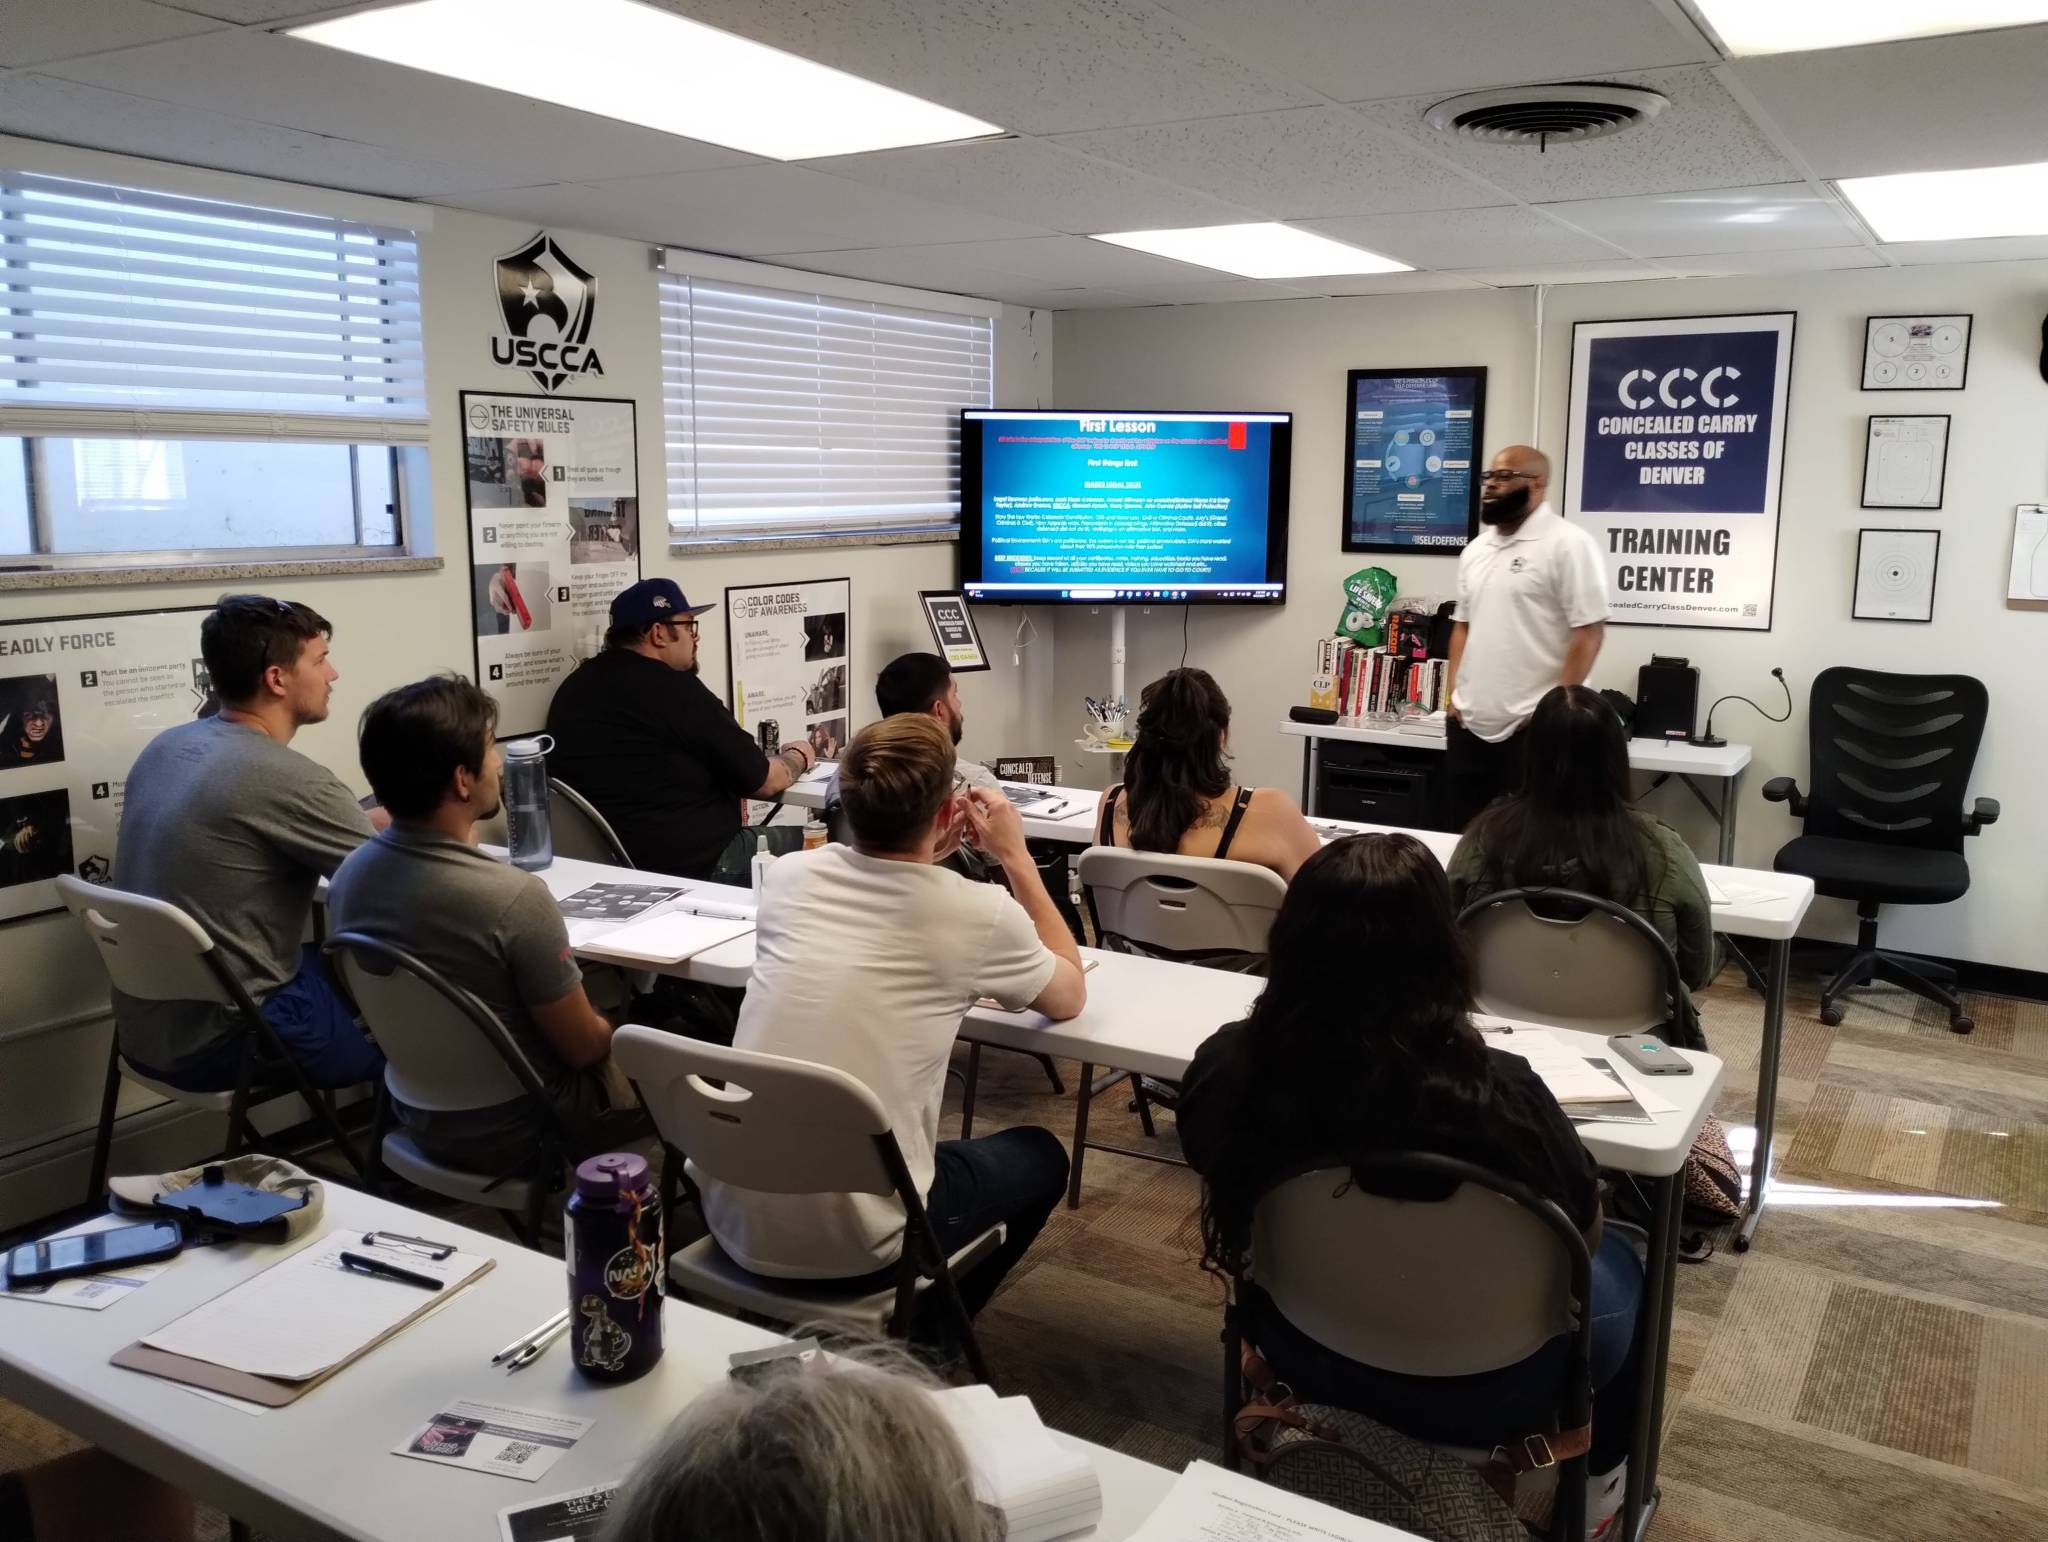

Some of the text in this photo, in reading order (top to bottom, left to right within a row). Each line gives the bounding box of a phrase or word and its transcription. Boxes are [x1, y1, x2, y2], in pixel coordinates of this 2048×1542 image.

[492, 336, 604, 375] USCCA
[1618, 366, 1741, 410] CCC
[491, 405, 574, 421] THE UNIVERSAL
[492, 419, 570, 433] SAFETY RULES
[1080, 420, 1156, 433] First Lesson
[1598, 414, 1758, 435] CONCEALED CARRY
[1624, 440, 1726, 460] CLASSES OF
[1640, 466, 1705, 485] DENVER
[1607, 528, 1731, 556] TRAINING
[1618, 565, 1714, 594] CENTER
[747, 593, 800, 607] COLOR CODES
[1608, 602, 1739, 613] cealedCarryClassDenver.com
[748, 604, 807, 618] OF AWARENESS
[938, 609, 960, 620] CCC
[1390, 614, 1399, 653] RAZOR
[0, 632, 116, 656] EADLY FORCE
[84, 673, 94, 686] 2
[1313, 680, 1331, 689] CLP
[1000, 762, 1033, 775] CONCEALED
[1028, 772, 1052, 784] DEFENSE
[609, 1262, 652, 1283] NASA
[565, 1496, 590, 1508] THE
